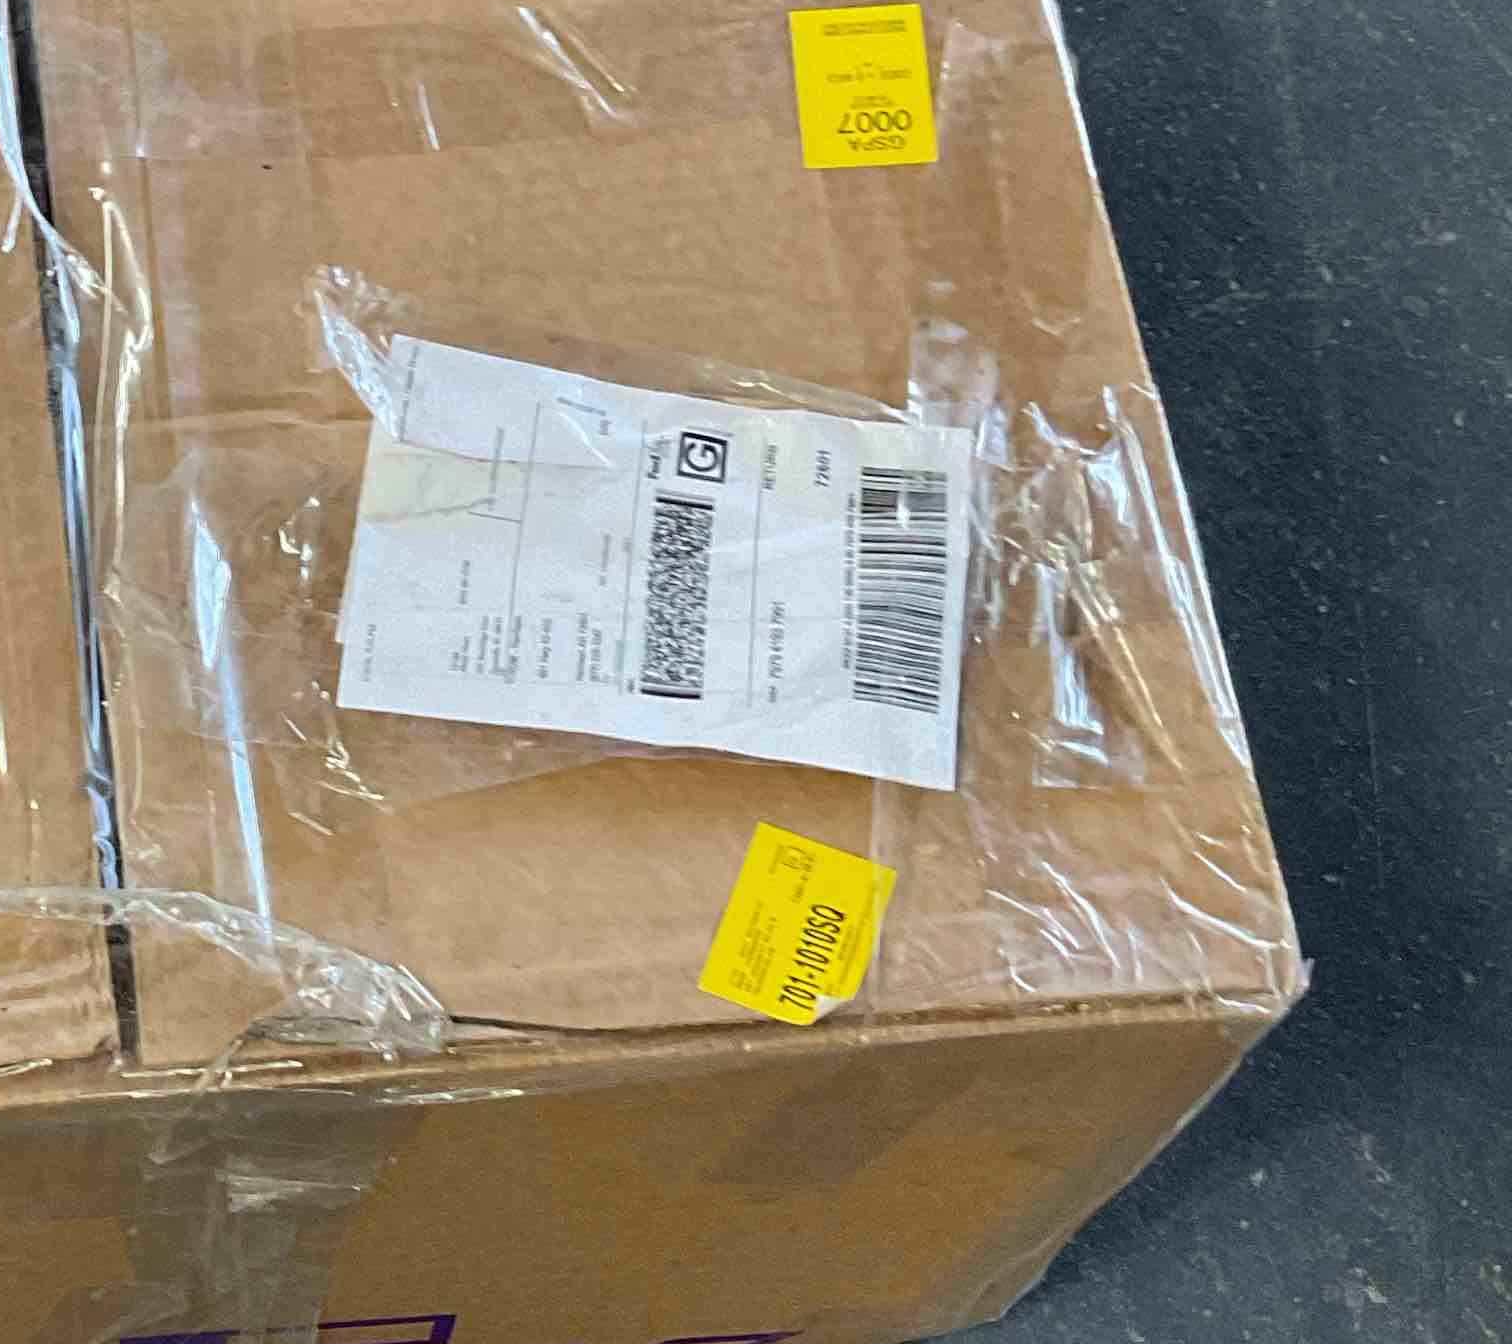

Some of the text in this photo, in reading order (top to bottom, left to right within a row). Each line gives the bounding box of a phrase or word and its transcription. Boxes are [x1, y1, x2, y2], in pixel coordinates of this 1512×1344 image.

[838, 110, 912, 133] 0007
[687, 442, 719, 472] G
[779, 904, 845, 1011] 701-1010SQ
